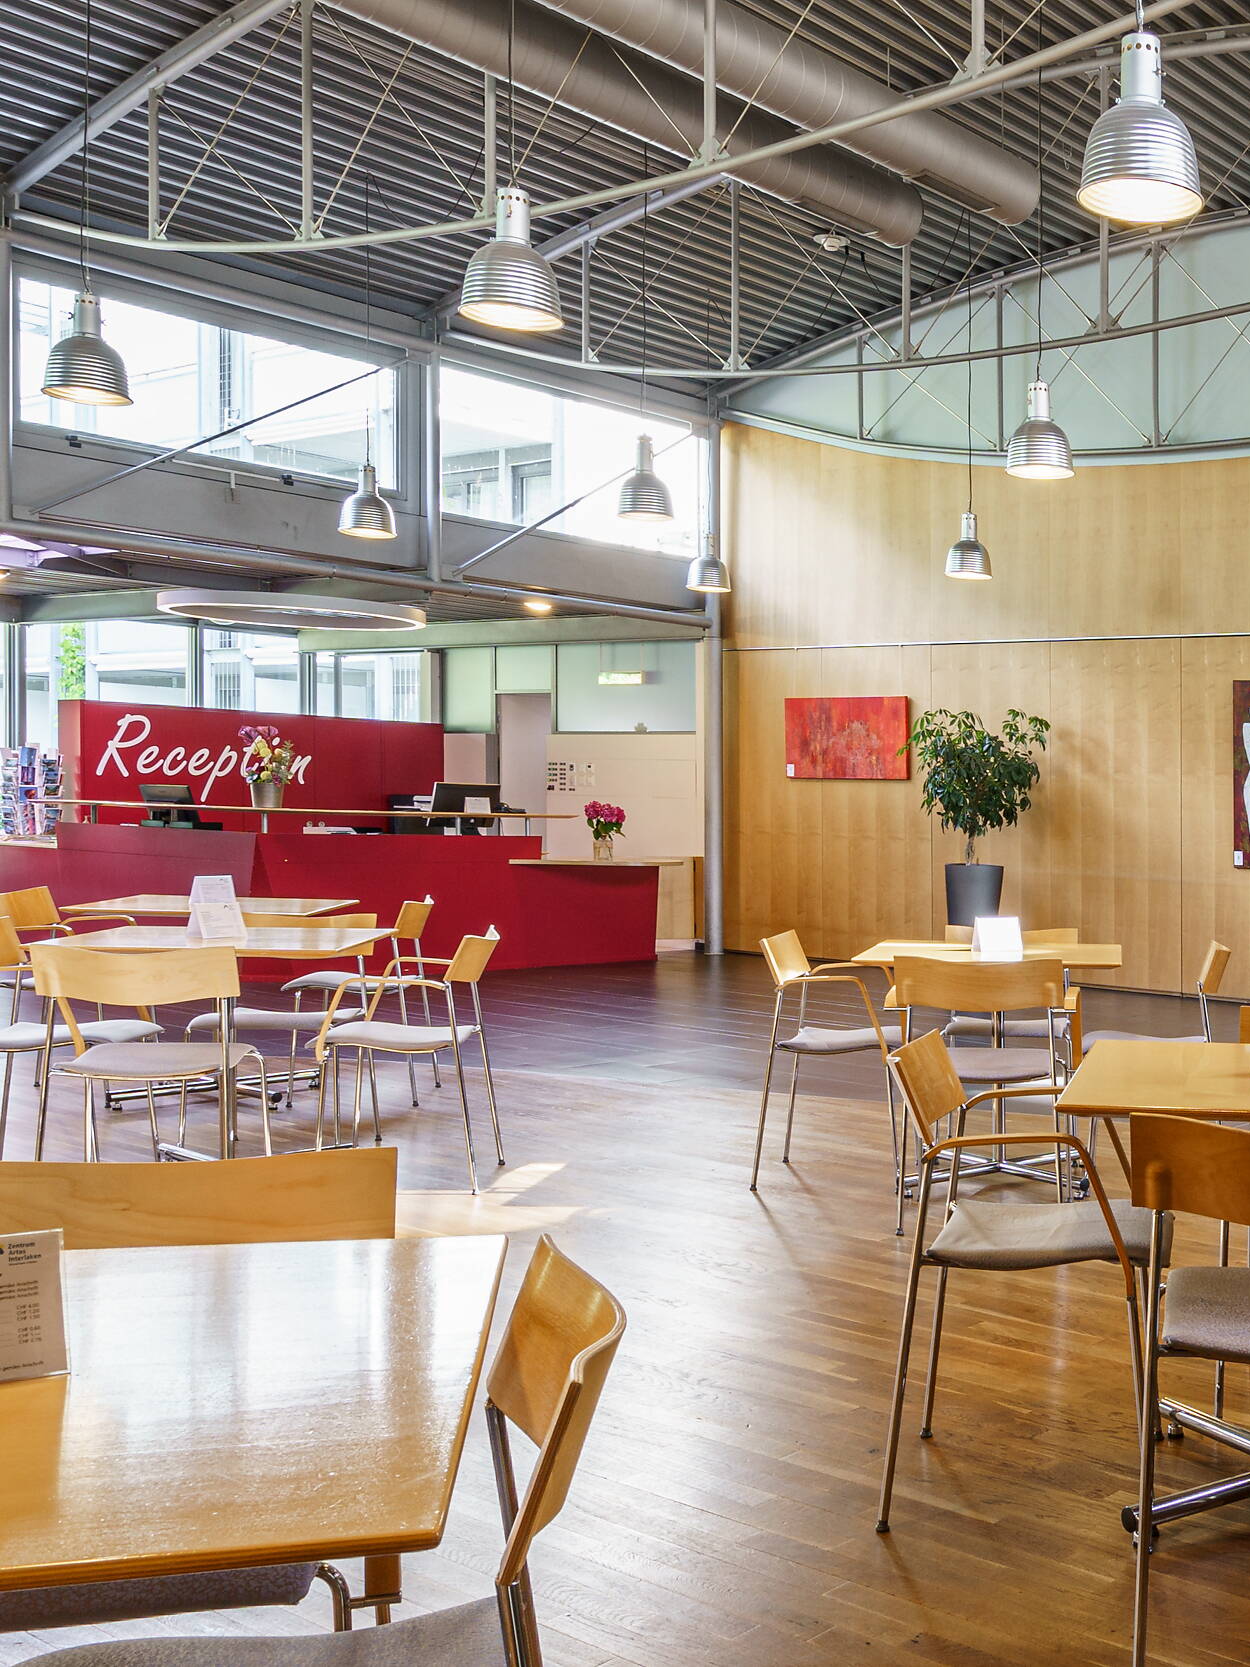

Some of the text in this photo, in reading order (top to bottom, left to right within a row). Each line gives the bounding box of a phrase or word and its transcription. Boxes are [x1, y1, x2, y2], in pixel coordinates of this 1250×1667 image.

[95, 713, 312, 802] Receptin
[7, 1241, 36, 1250] Zentrum
[8, 1253, 42, 1262] Interlaken
